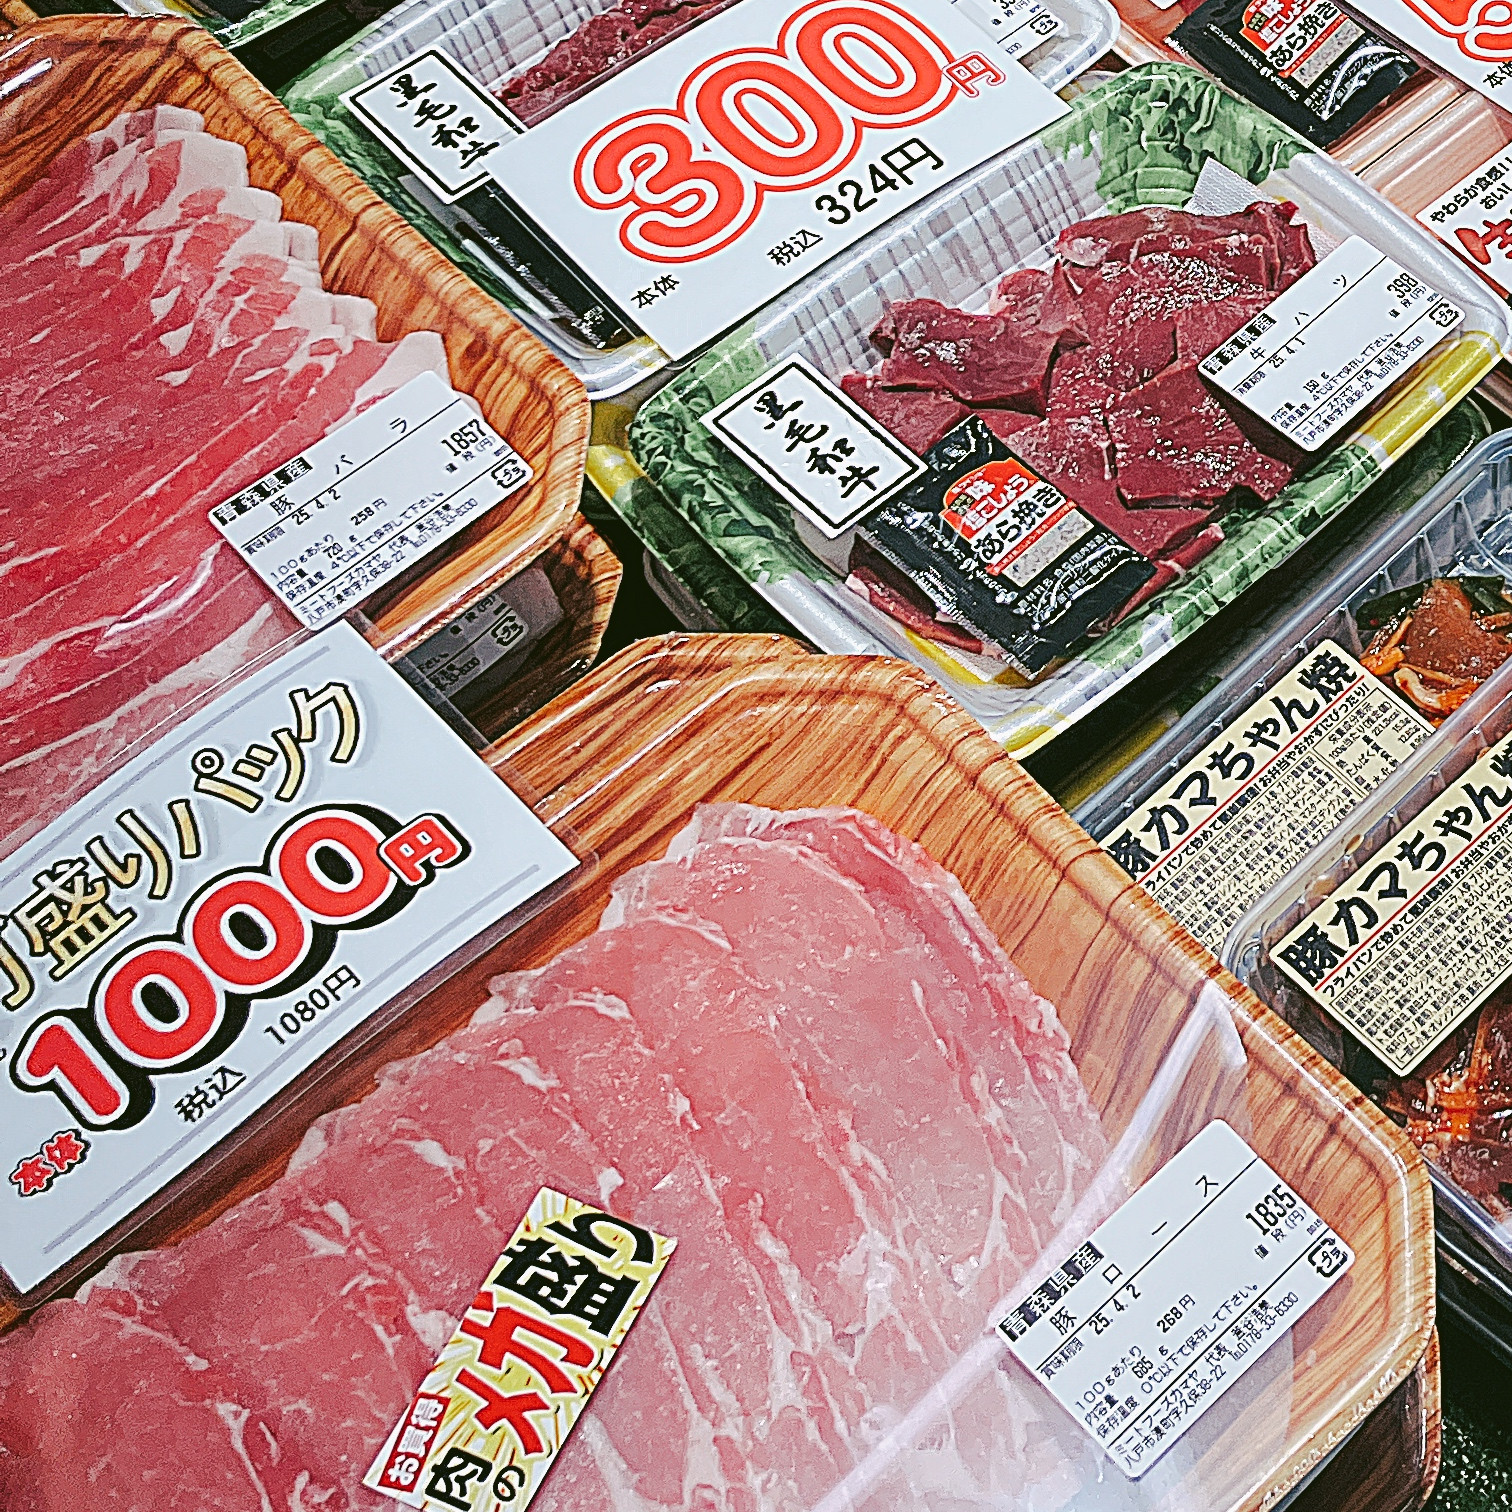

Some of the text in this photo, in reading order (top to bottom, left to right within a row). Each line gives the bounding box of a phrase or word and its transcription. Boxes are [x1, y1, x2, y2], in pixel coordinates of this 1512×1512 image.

[1267, 0, 1340, 69] あら挽き
[764, 136, 946, 269] 税込 324円
[629, 273, 681, 312] 本体
[1386, 272, 1419, 299] 398
[441, 418, 487, 457] 1857
[751, 390, 883, 501] 黒毛和牛
[974, 479, 1069, 563] あら挽き
[1107, 650, 1358, 883] 豚カマちゃん焼
[12, 803, 473, 1134] 1000円
[175, 964, 363, 1125] 税込 1080円
[1245, 1184, 1298, 1236] 1835
[999, 1240, 1105, 1342] 青森県産
[1050, 1174, 1219, 1336] 豚ロース
[1156, 1293, 1196, 1334] 268円
[1132, 1356, 1155, 1380] 685
